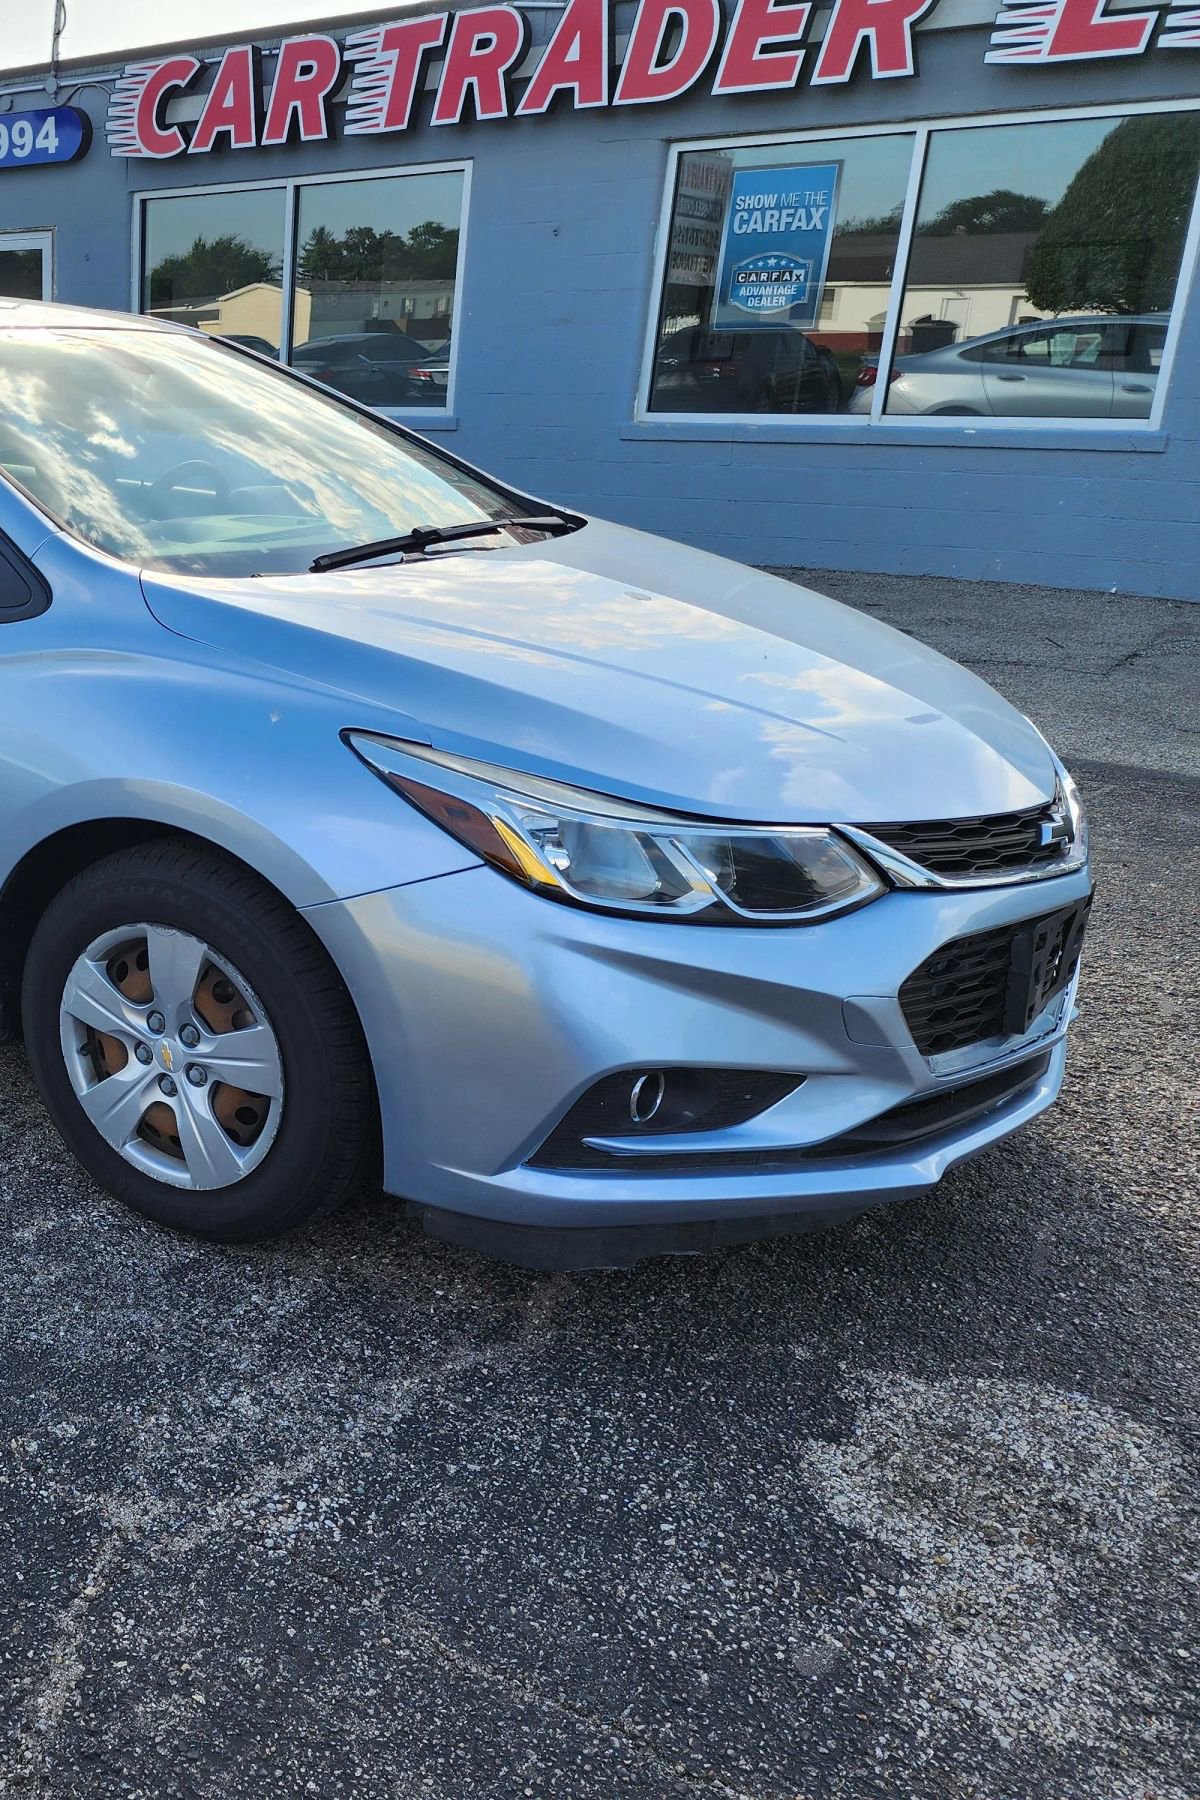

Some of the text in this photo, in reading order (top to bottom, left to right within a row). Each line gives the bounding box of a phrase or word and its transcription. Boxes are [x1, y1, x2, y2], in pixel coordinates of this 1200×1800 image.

[105, 34, 331, 159] CAR
[344, 0, 936, 134] TRADER
[735, 193, 778, 210] SHOW
[780, 192, 801, 207] ME
[803, 190, 829, 206] THE
[733, 207, 826, 235] CARFAX
[737, 271, 803, 283] CARFAX
[739, 284, 798, 296] ADVANTAGE
[747, 296, 786, 307] DEALER
